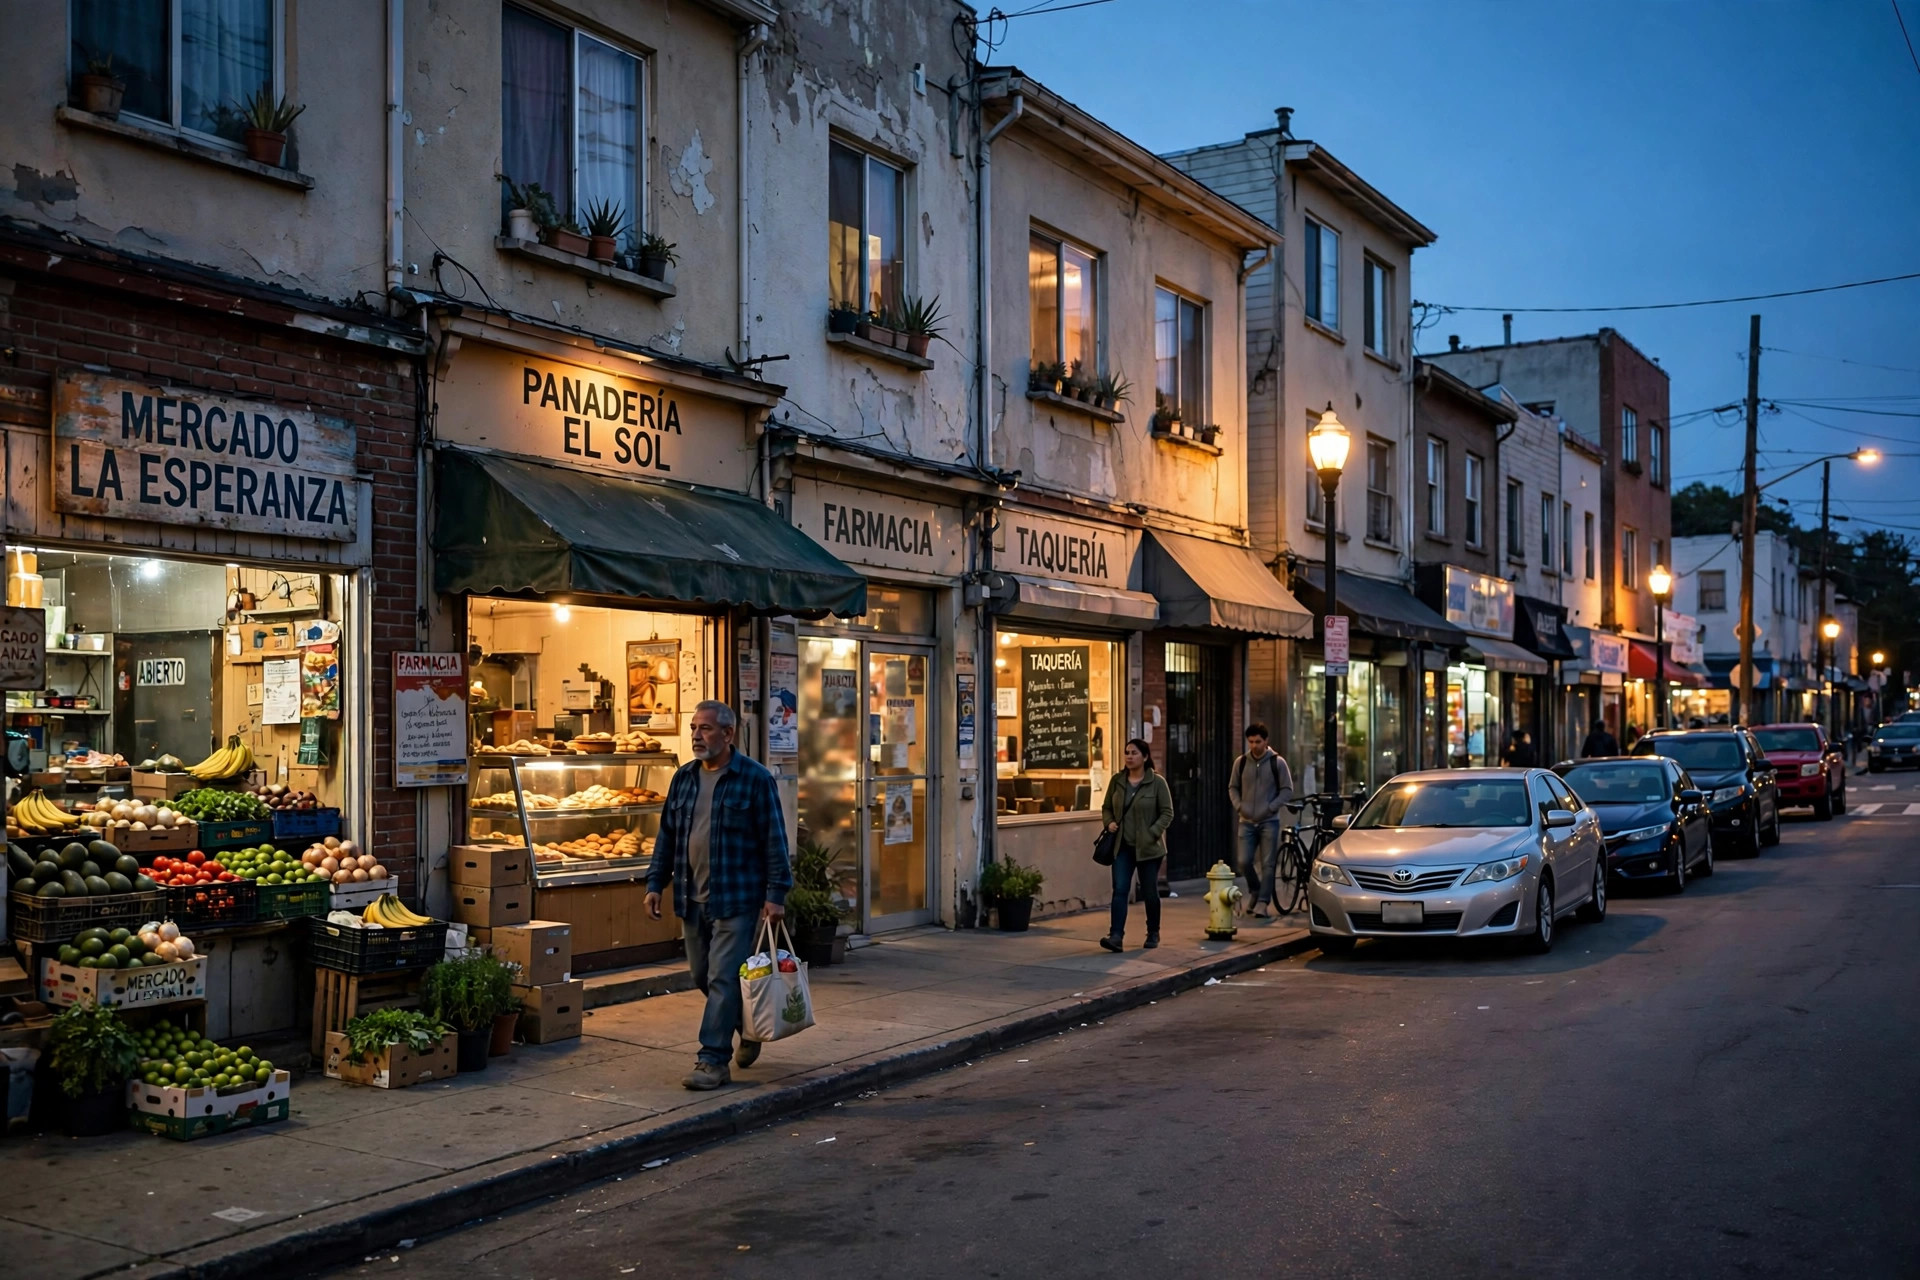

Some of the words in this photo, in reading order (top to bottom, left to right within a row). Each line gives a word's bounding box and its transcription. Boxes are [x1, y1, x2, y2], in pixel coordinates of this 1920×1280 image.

[121, 391, 299, 464] MERCADO
[523, 367, 682, 435] PANADERÍA
[564, 416, 602, 460] EL
[614, 427, 671, 472] SOL
[71, 444, 123, 501] LA
[139, 453, 349, 526] ESPERANZA
[824, 503, 933, 556] FARMACIA
[1016, 526, 1109, 579] TAQUERÍA
[138, 660, 184, 684] ABIERTO
[398, 655, 458, 671] FARMACIA
[1030, 650, 1082, 672] TAQUERÍA
[126, 968, 187, 990] MERCADO
